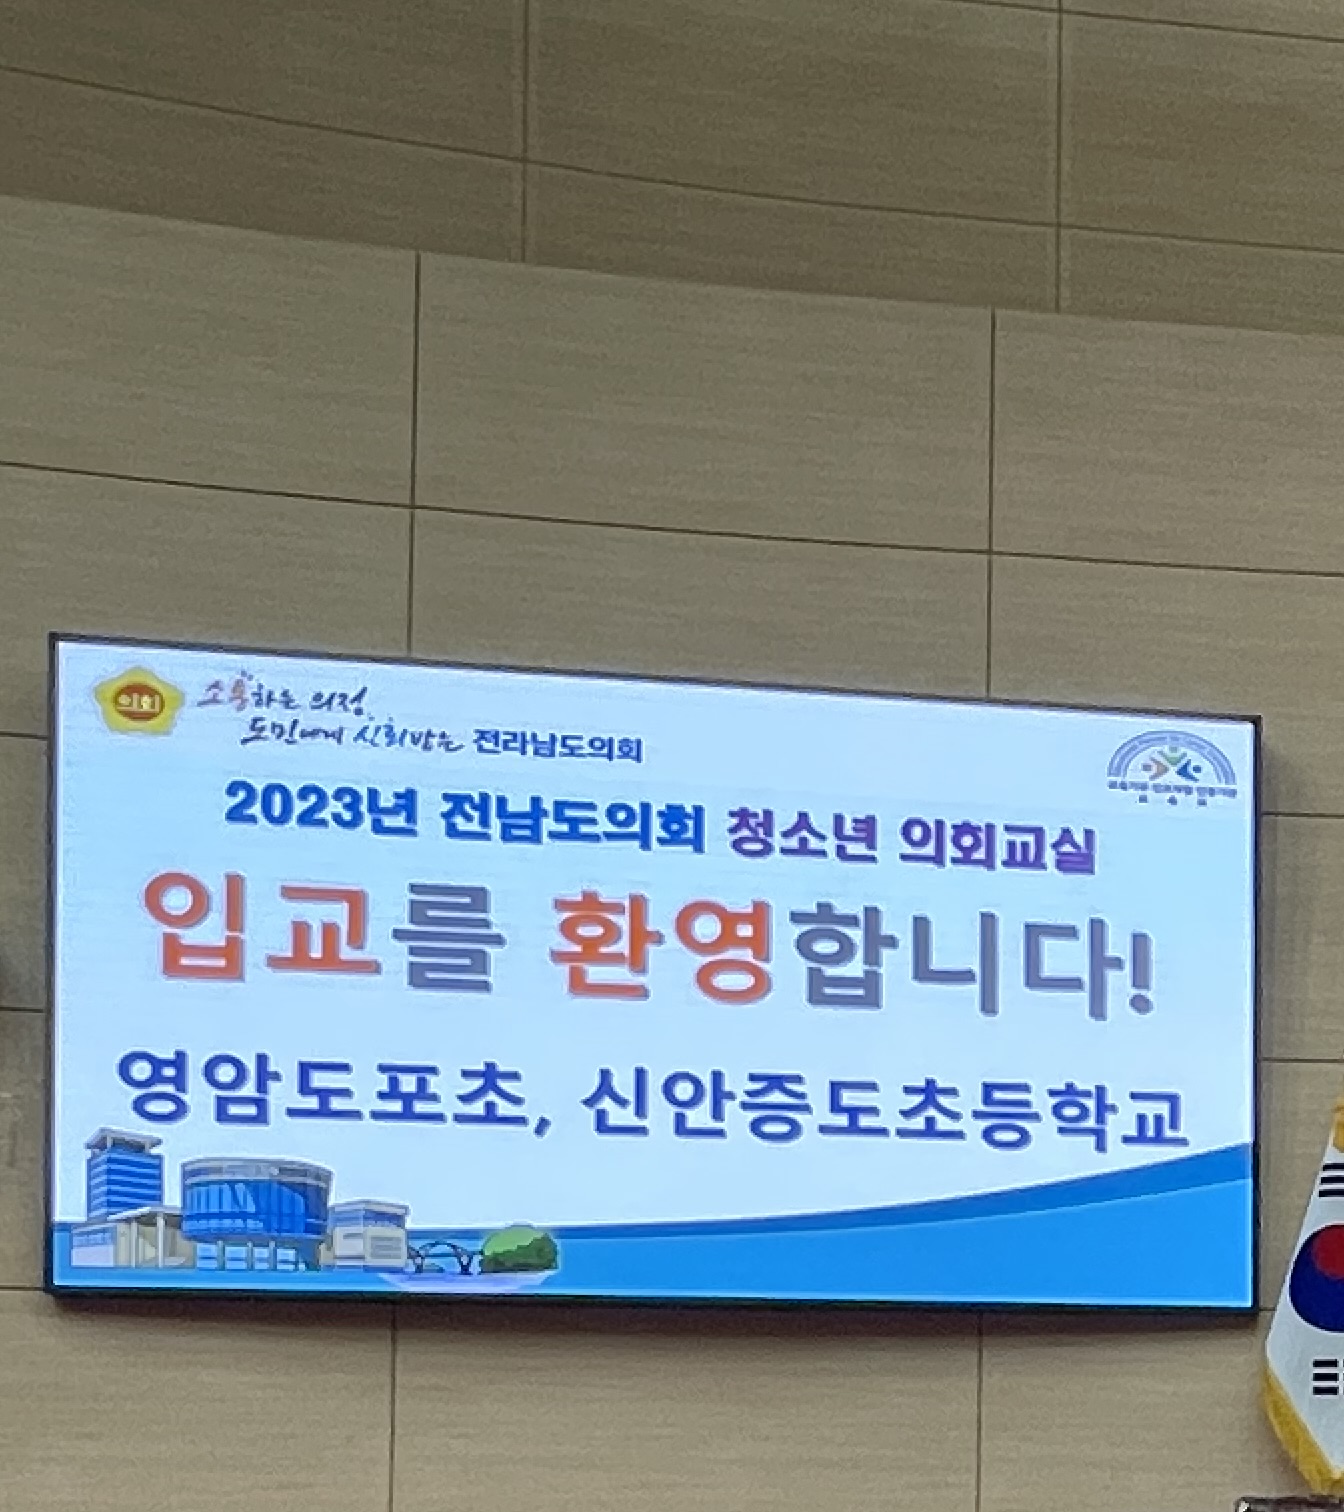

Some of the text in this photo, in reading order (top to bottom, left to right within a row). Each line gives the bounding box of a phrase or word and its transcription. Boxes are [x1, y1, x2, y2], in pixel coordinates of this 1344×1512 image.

[115, 691, 160, 713] 의회
[473, 729, 641, 763] 전라남도의회
[225, 781, 1095, 875] 2023년 전남도의회 청소년 의회교실
[145, 873, 1153, 1021] 입교를 환영합니다!
[117, 1050, 1190, 1154] 영암도포초, 신안증도초등학교
